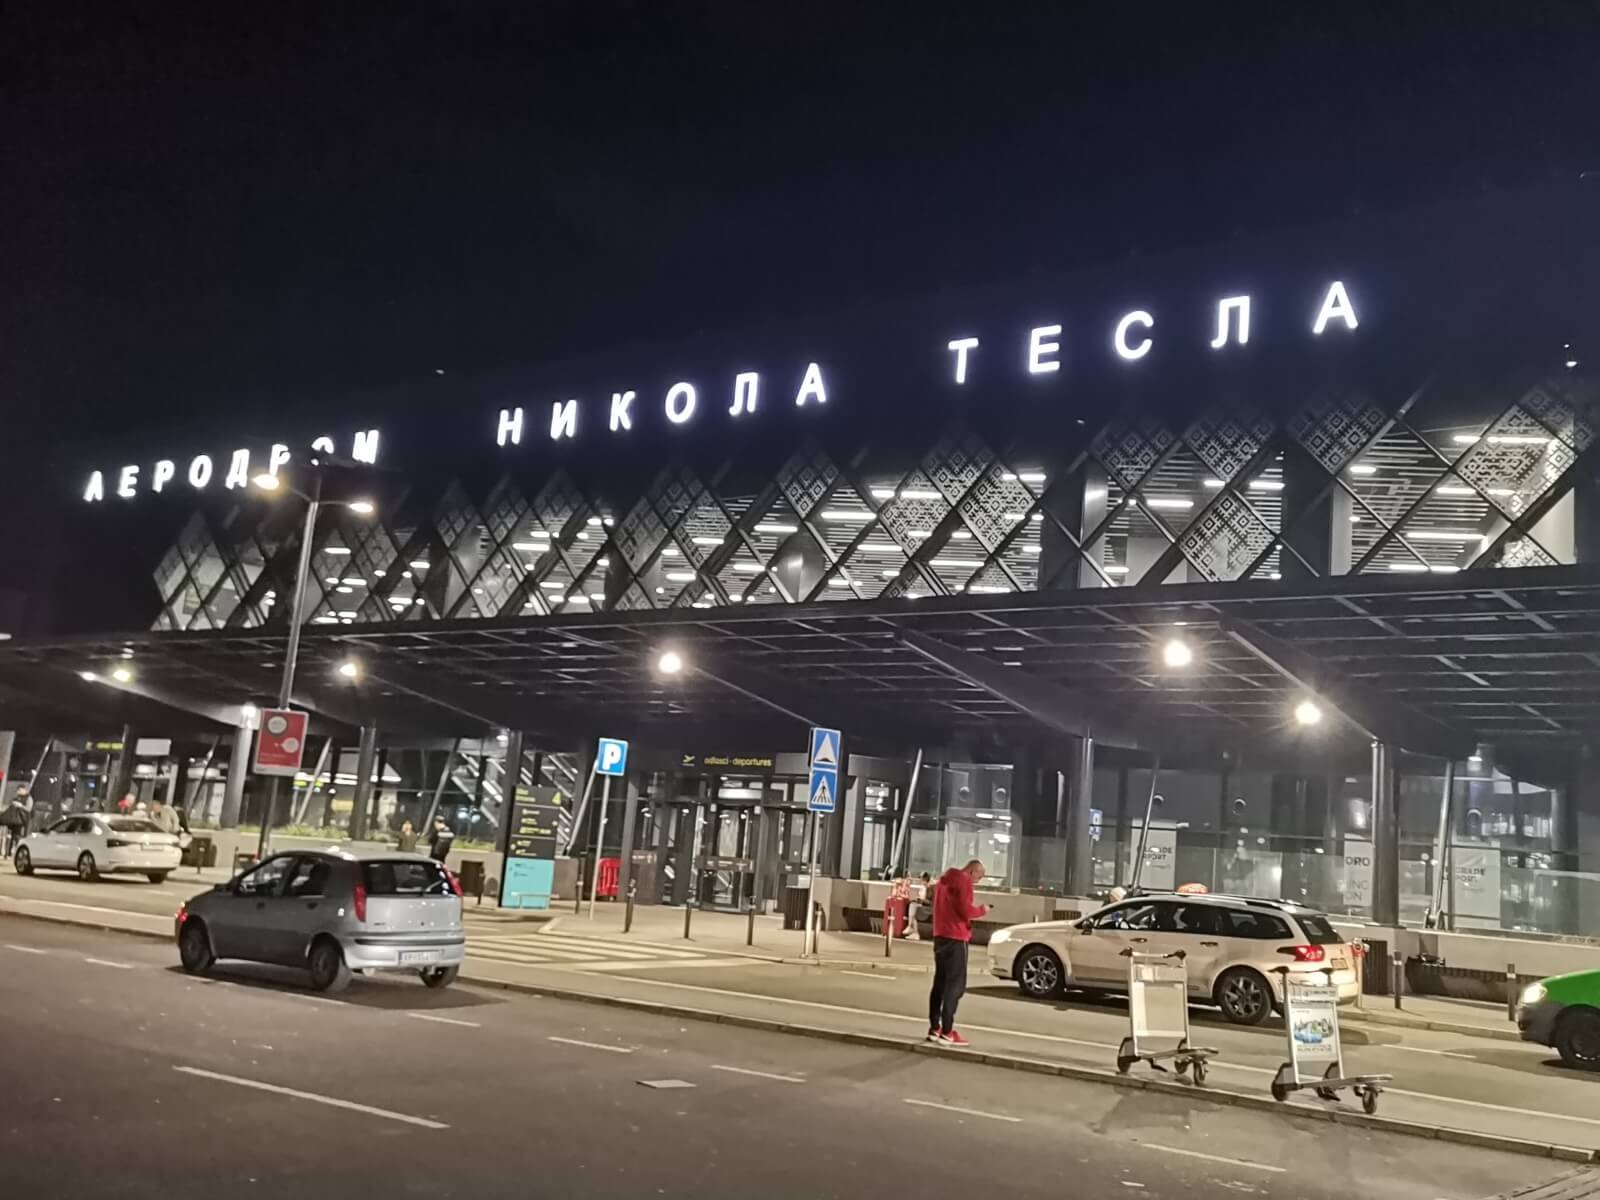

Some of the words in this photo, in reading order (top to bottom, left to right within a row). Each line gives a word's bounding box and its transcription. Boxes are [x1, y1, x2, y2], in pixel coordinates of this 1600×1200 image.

[497, 363, 828, 446] НИКОЛА
[947, 281, 1359, 384] ТЕСЛА
[602, 743, 622, 770] P
